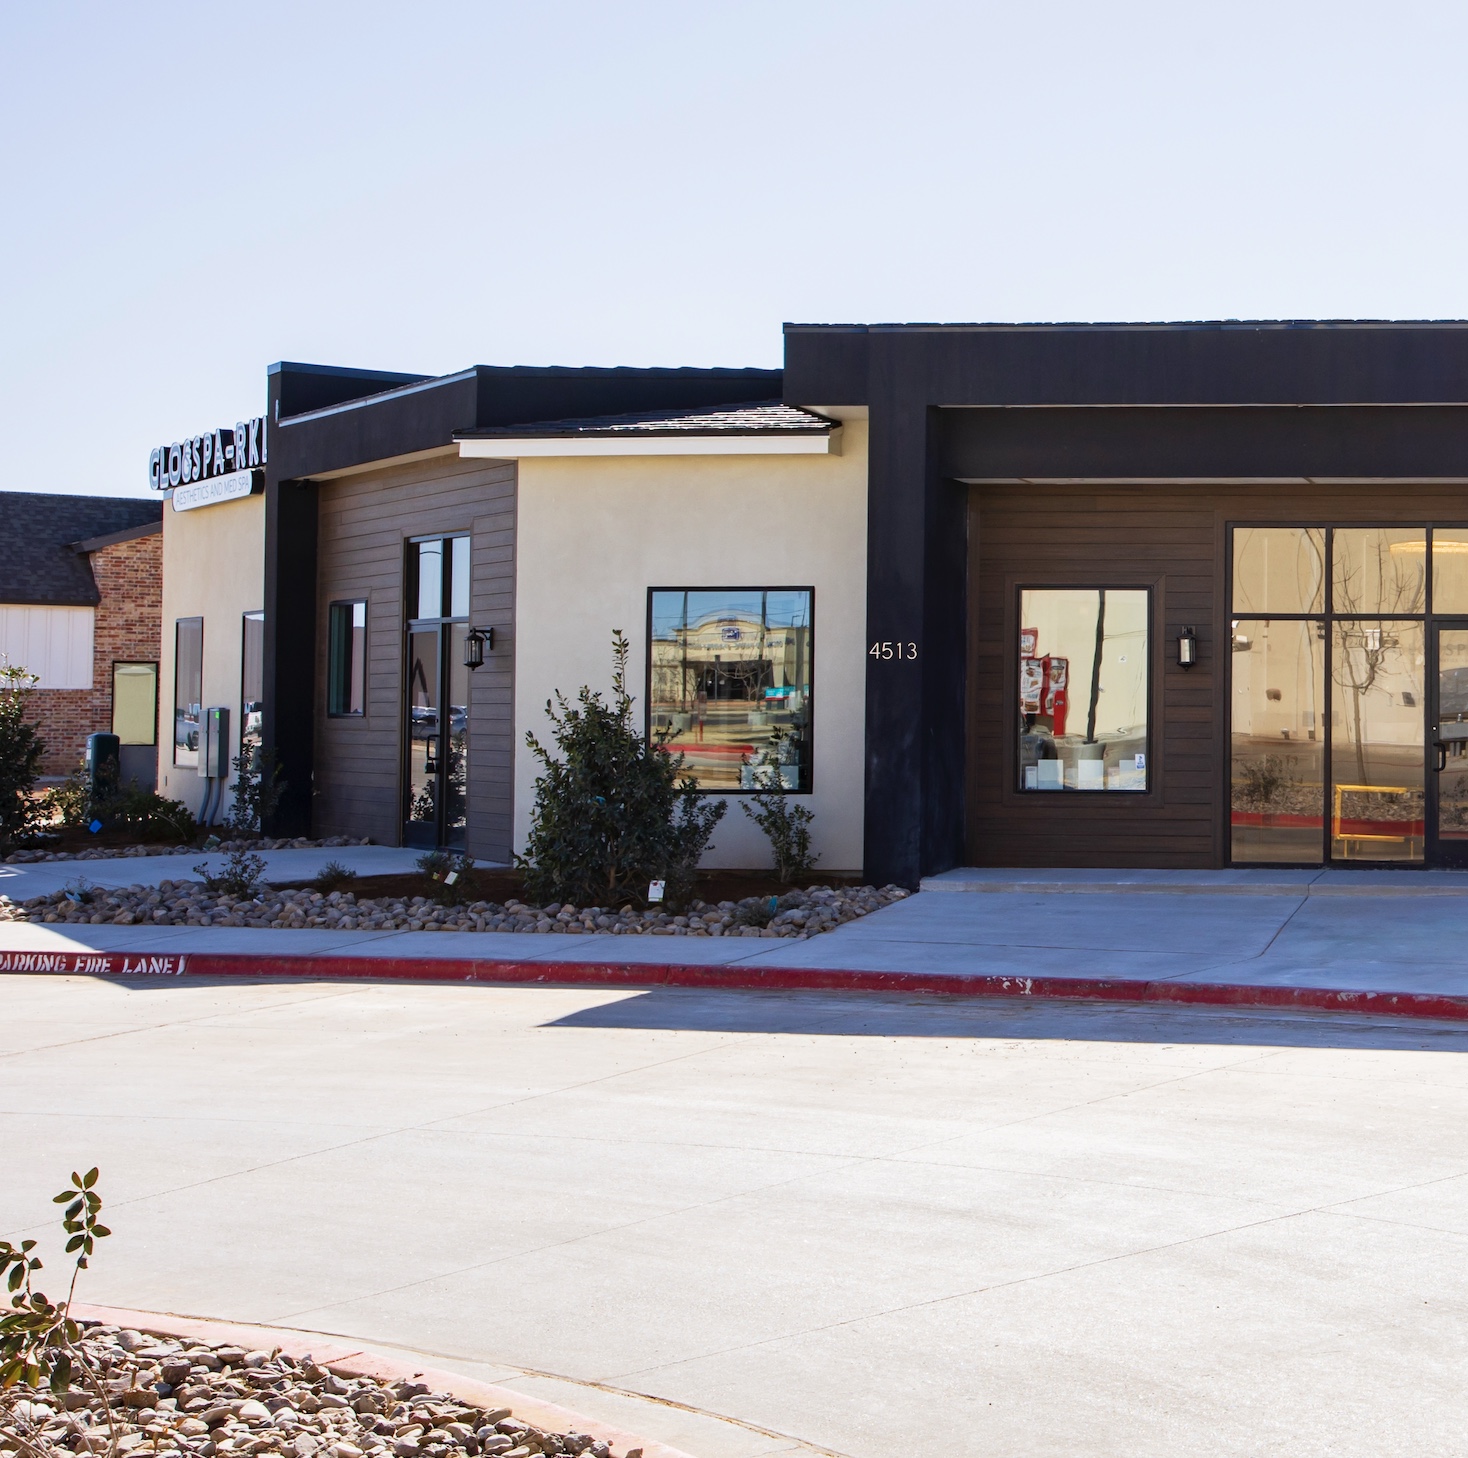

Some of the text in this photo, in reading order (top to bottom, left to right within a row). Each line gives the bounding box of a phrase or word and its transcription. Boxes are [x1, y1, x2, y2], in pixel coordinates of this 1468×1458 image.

[175, 475, 250, 506] AESTHETICS AND MED SPA
[869, 642, 918, 660] 4513
[73, 955, 113, 973] FIRE
[121, 955, 175, 974] LANE
